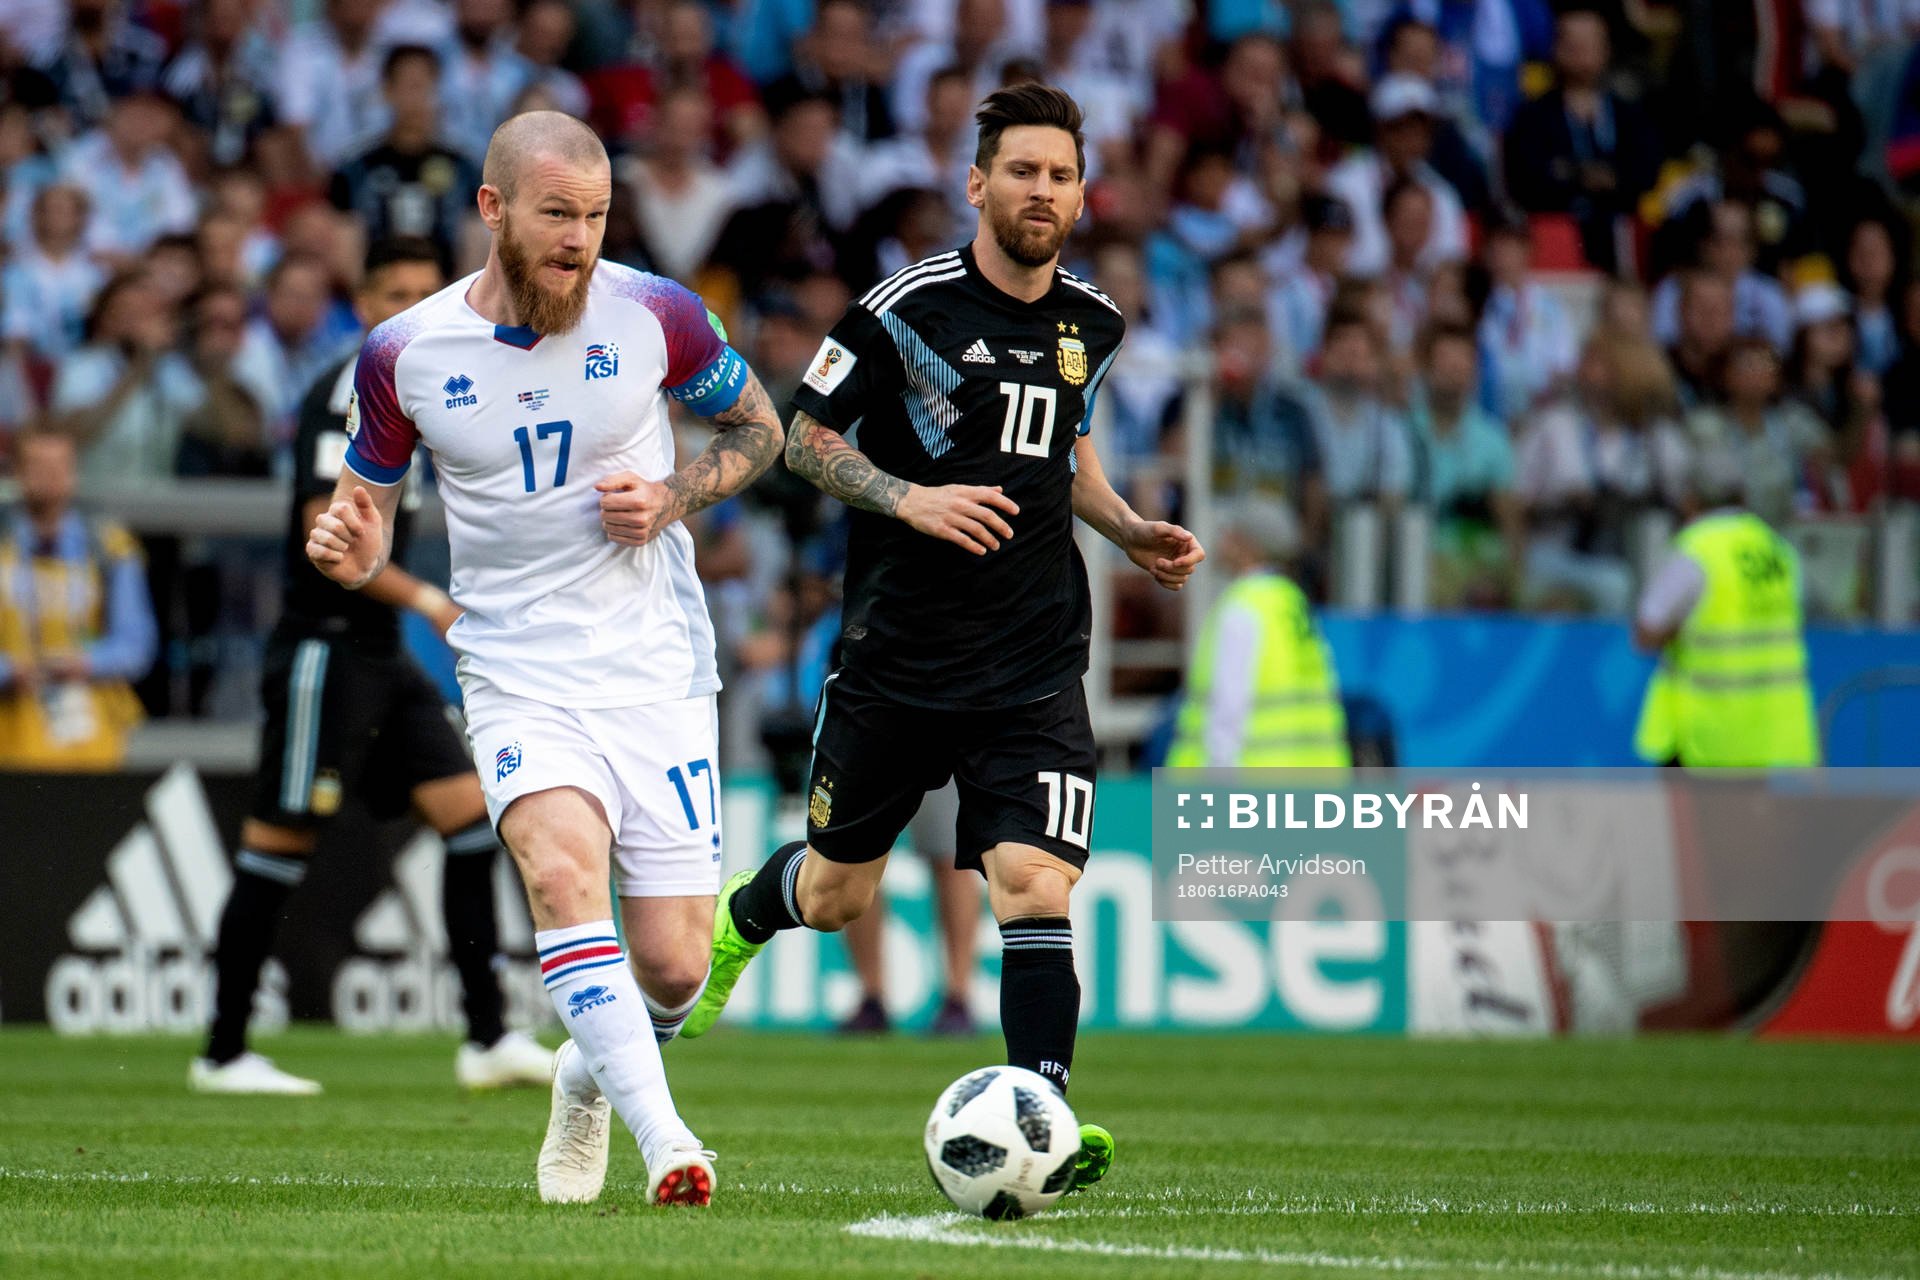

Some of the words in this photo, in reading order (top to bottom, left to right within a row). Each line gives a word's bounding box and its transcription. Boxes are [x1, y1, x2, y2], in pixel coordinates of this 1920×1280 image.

[728, 360, 742, 387] FIFA
[962, 353, 996, 364] adidas
[1000, 381, 1057, 458] 10
[514, 420, 573, 493] 17
[667, 758, 716, 831] 17
[1038, 771, 1093, 850] 10
[45, 938, 292, 1035] adids
[1040, 1060, 1070, 1086] AFA
